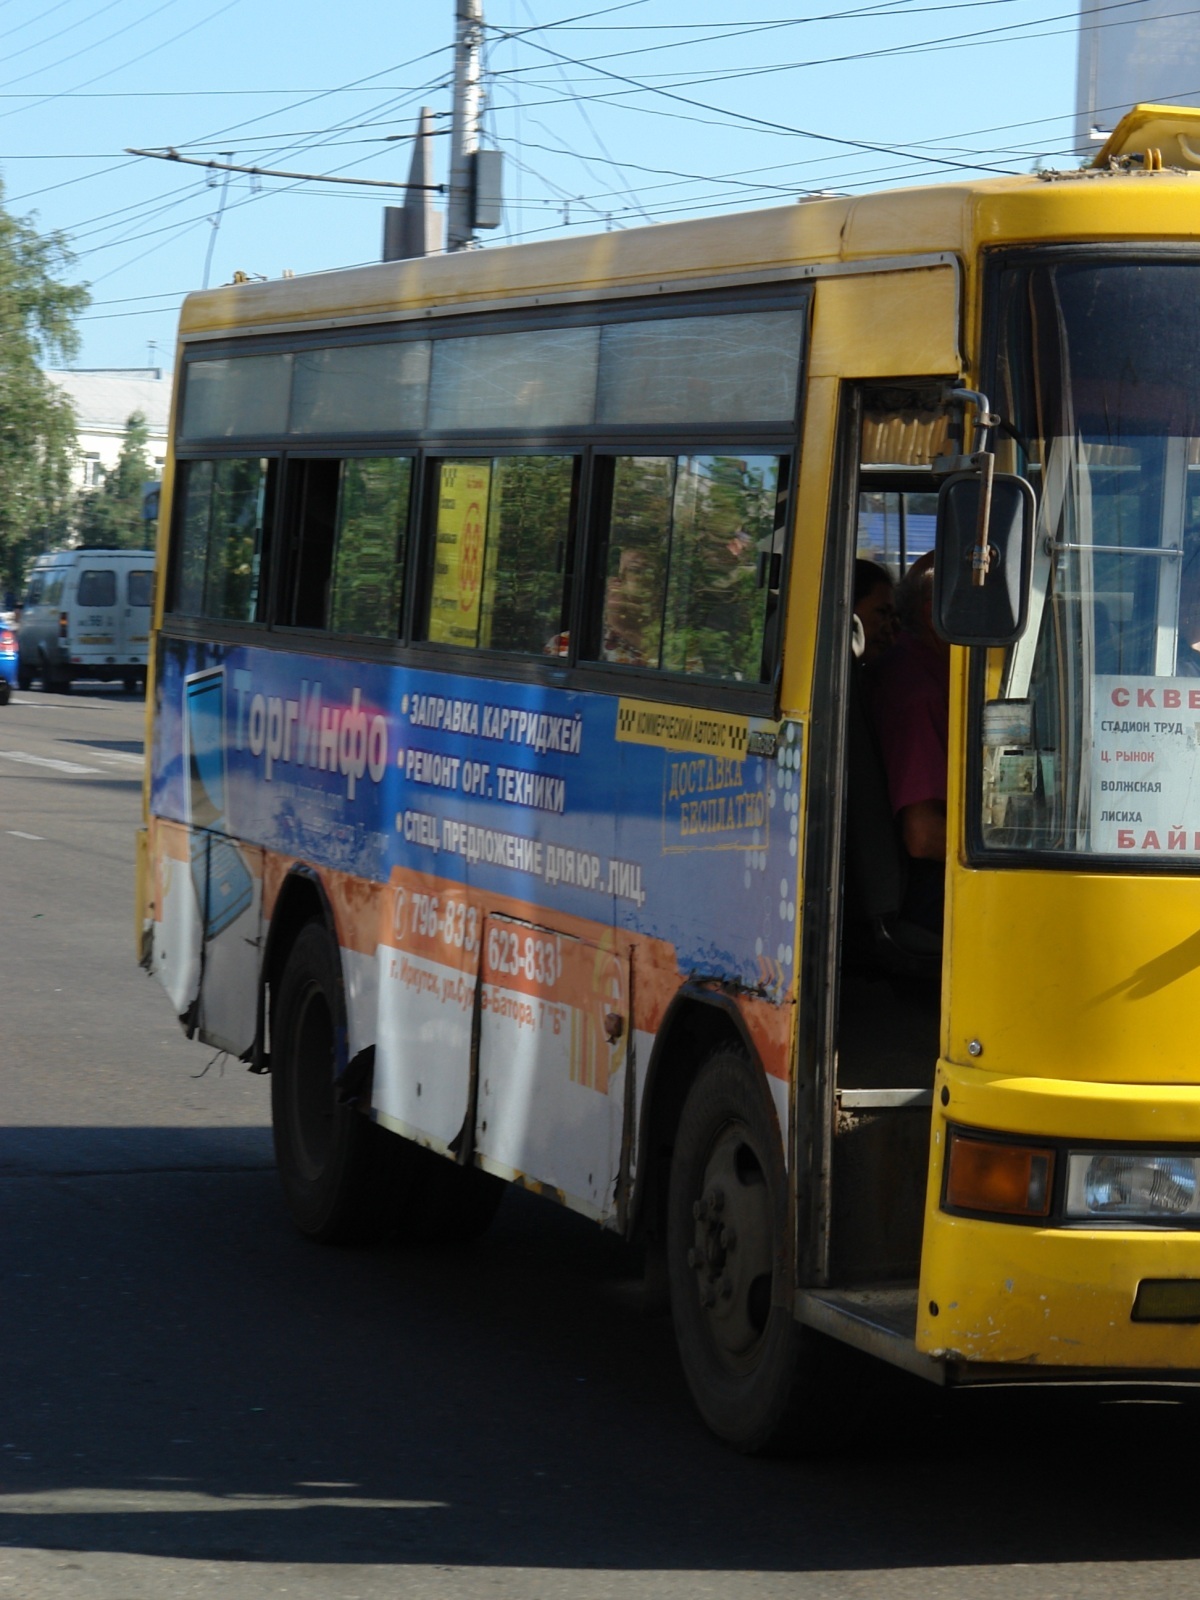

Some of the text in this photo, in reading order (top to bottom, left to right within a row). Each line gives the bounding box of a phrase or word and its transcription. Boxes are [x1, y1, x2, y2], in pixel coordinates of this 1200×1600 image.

[233, 668, 388, 801] ТоргИнфо
[409, 694, 583, 754] ЗАПРАВКА КАРТРИДЖЕЙ
[637, 712, 692, 740] КОММЕРЧЕСКИЙ
[693, 720, 727, 747] АВТОБУС
[1101, 720, 1183, 734] СТАДИОН ТРУД
[669, 756, 743, 800] ДОСТАВКА
[1101, 750, 1155, 763] Ц. РЫНОК
[405, 749, 566, 813] РЕМОНТ ОРГ. ТЕХНИКИ
[1101, 780, 1162, 793] ВОЛЖСКАЯ
[680, 791, 766, 836] БЕСПЛАТНО
[1100, 811, 1142, 822] ЛИСИХА
[443, 819, 542, 875] ПРЕДЛОЖЕНИЕ
[545, 844, 575, 885] ДЛЯ
